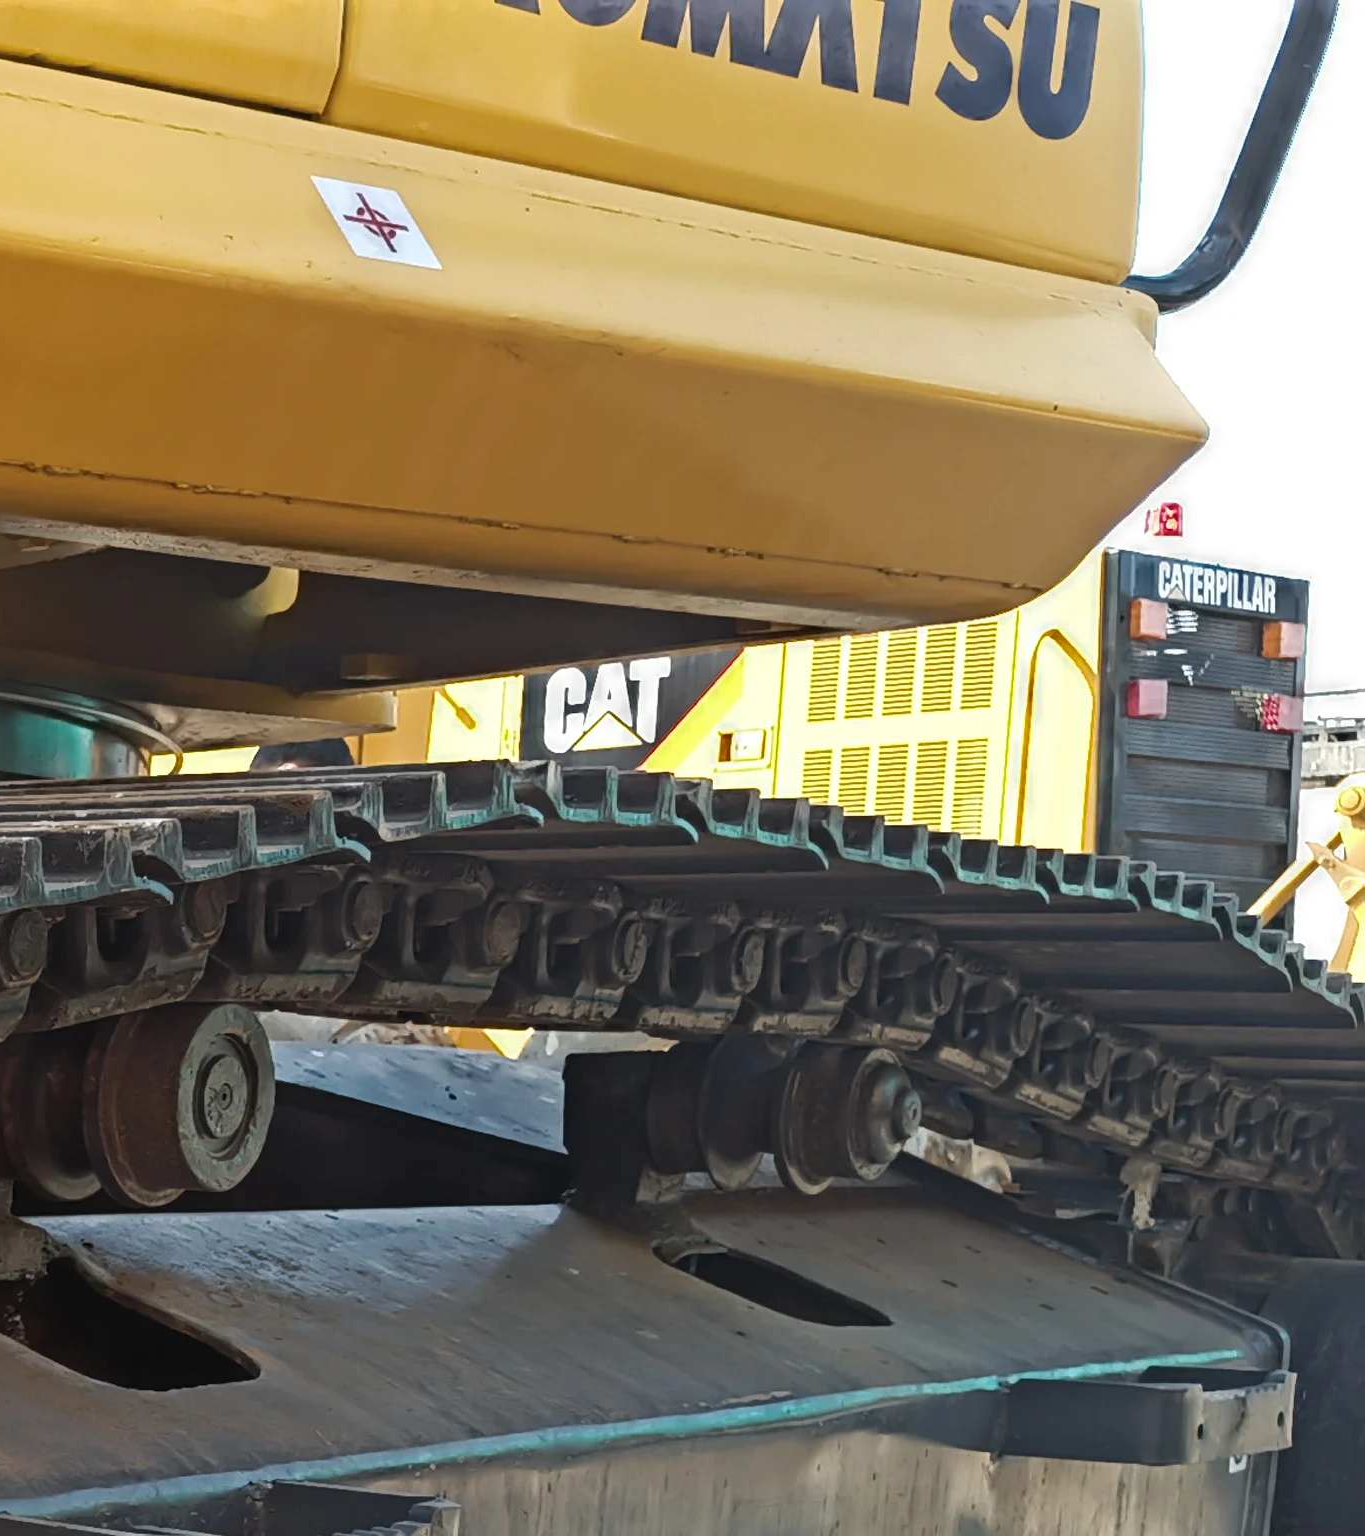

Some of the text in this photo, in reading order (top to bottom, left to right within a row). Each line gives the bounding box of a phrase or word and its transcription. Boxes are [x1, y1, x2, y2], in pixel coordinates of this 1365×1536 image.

[494, 0, 1100, 140] ATSU
[1158, 561, 1276, 614] CATERPILLAR
[544, 656, 671, 753] CAT
